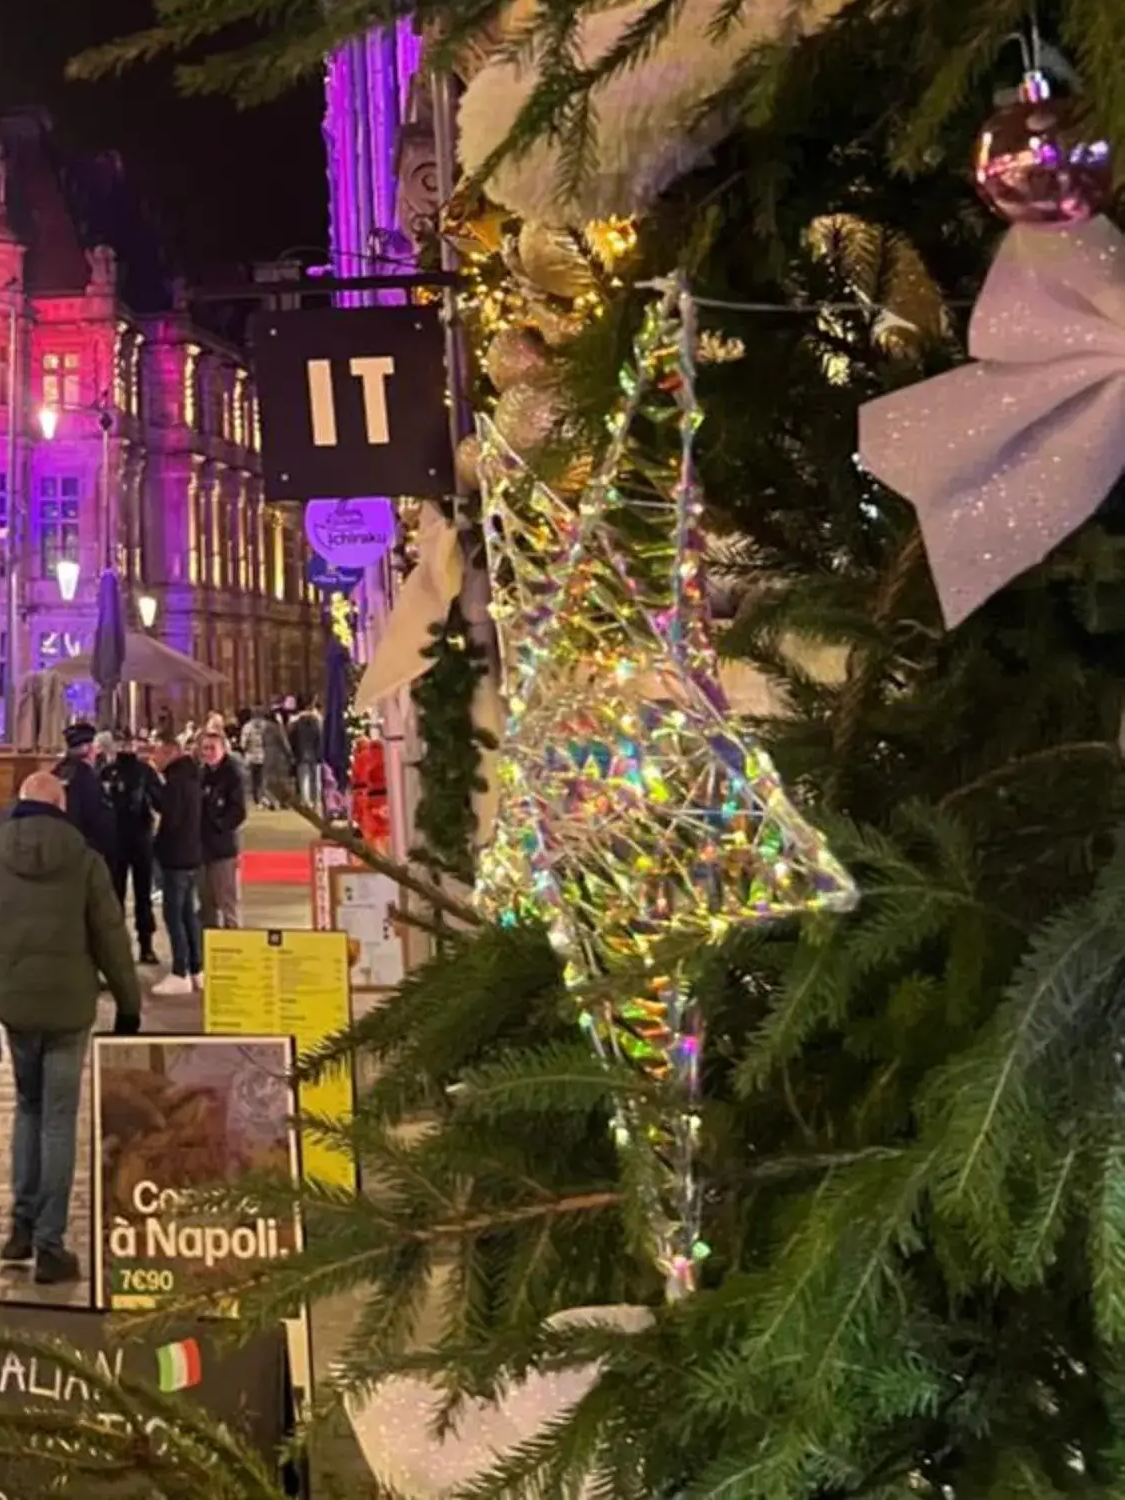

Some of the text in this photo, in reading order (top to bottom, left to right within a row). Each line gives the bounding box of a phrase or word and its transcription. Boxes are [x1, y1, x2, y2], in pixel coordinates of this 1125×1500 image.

[306, 356, 395, 447] IT
[110, 1216, 290, 1267] à Napoli.
[119, 1269, 175, 1292] 7€90
